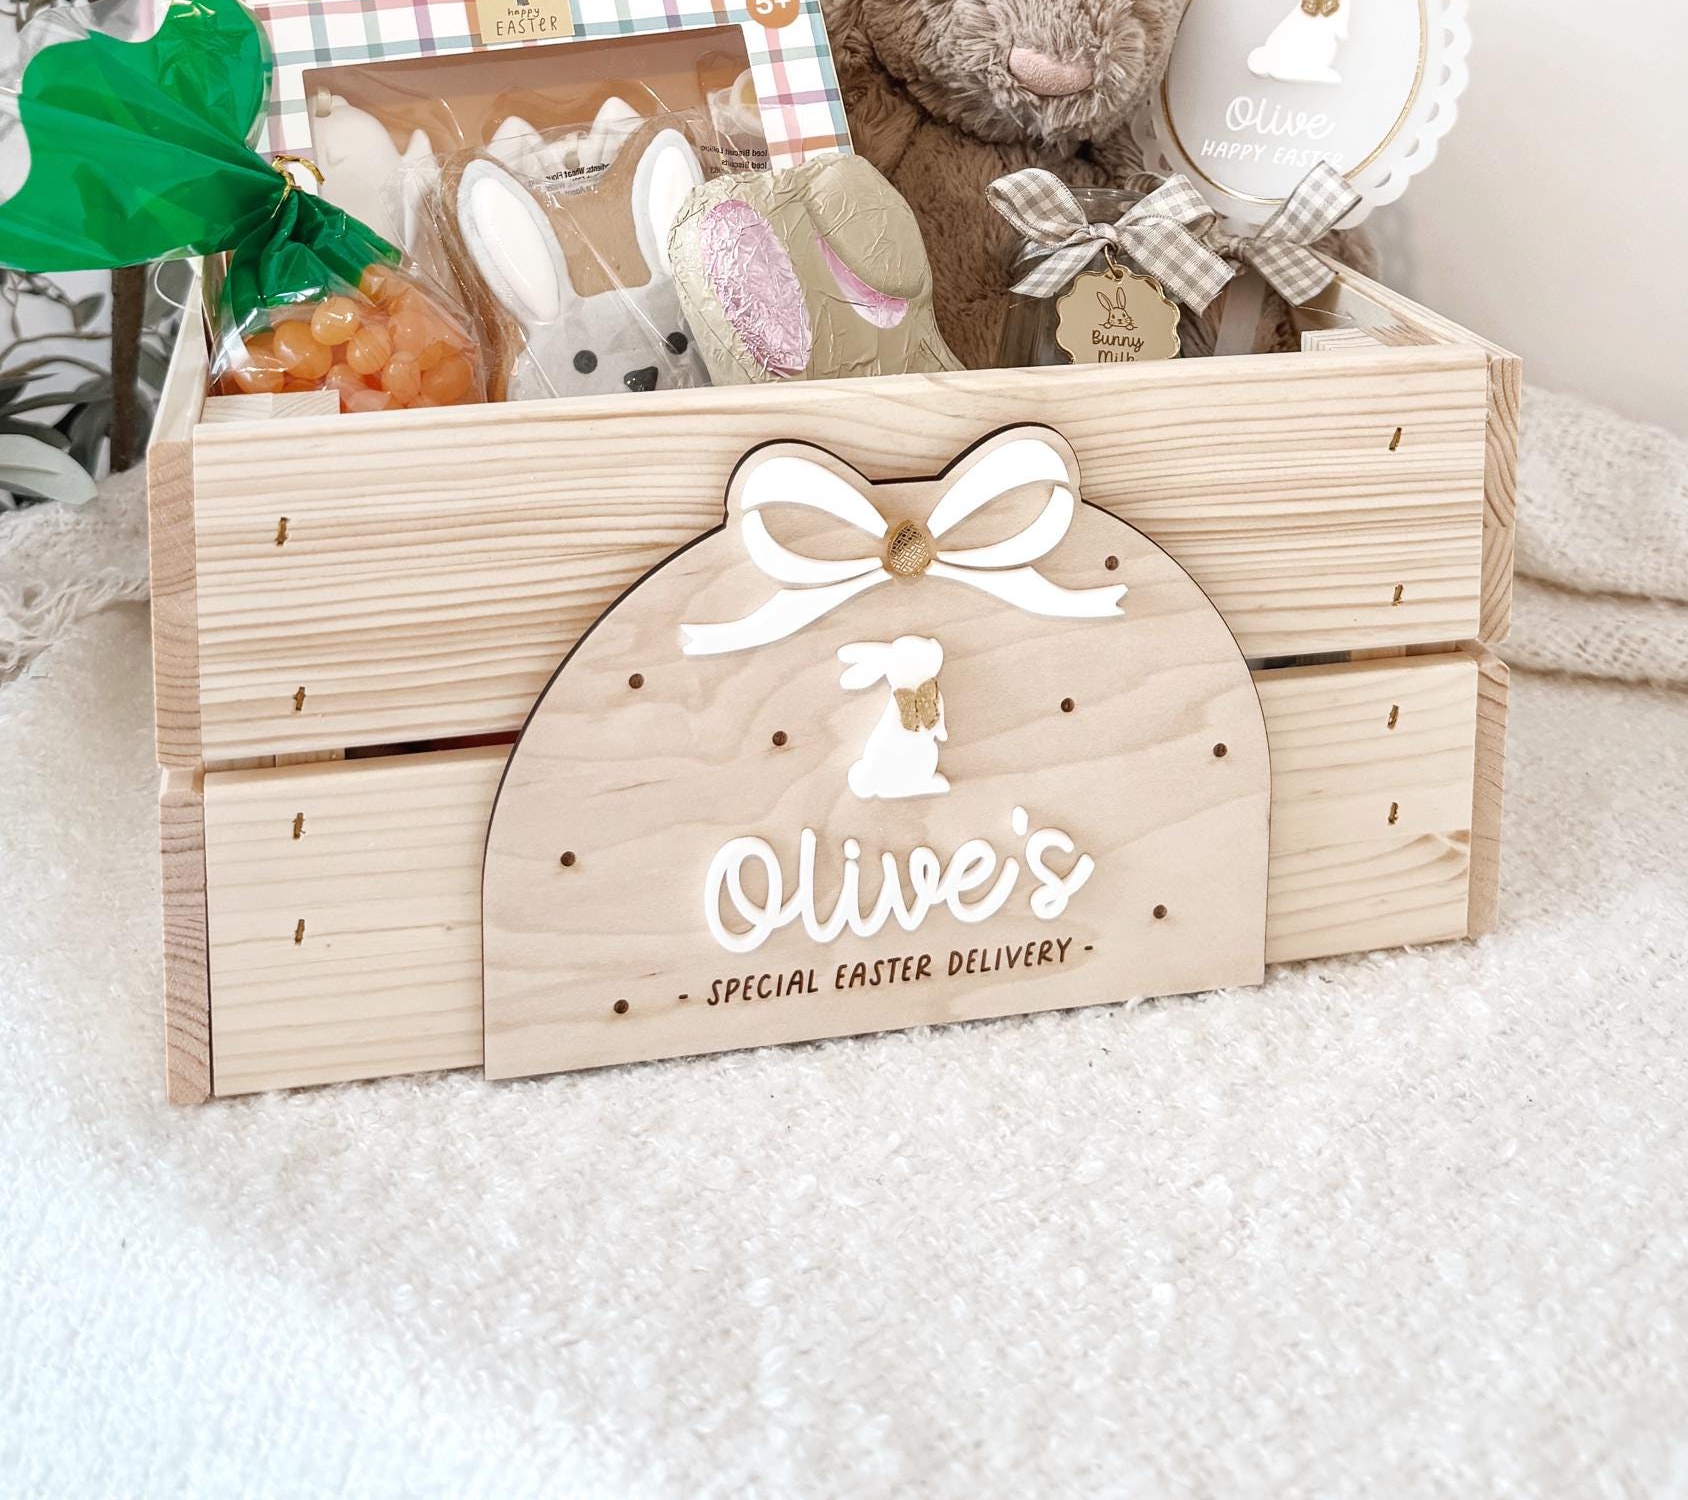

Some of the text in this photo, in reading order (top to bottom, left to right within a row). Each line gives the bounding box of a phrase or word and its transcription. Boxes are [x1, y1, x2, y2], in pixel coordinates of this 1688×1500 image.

[507, 7, 540, 18] happy
[1225, 96, 1336, 139] Olive
[1200, 139, 1344, 169] HAPPY EASTER
[1092, 329, 1144, 352] Bunny
[704, 806, 1095, 953] Olive's
[706, 968, 819, 1006] SPECIAL
[834, 953, 932, 989] EASTER
[947, 936, 1072, 976] DELIVERY
